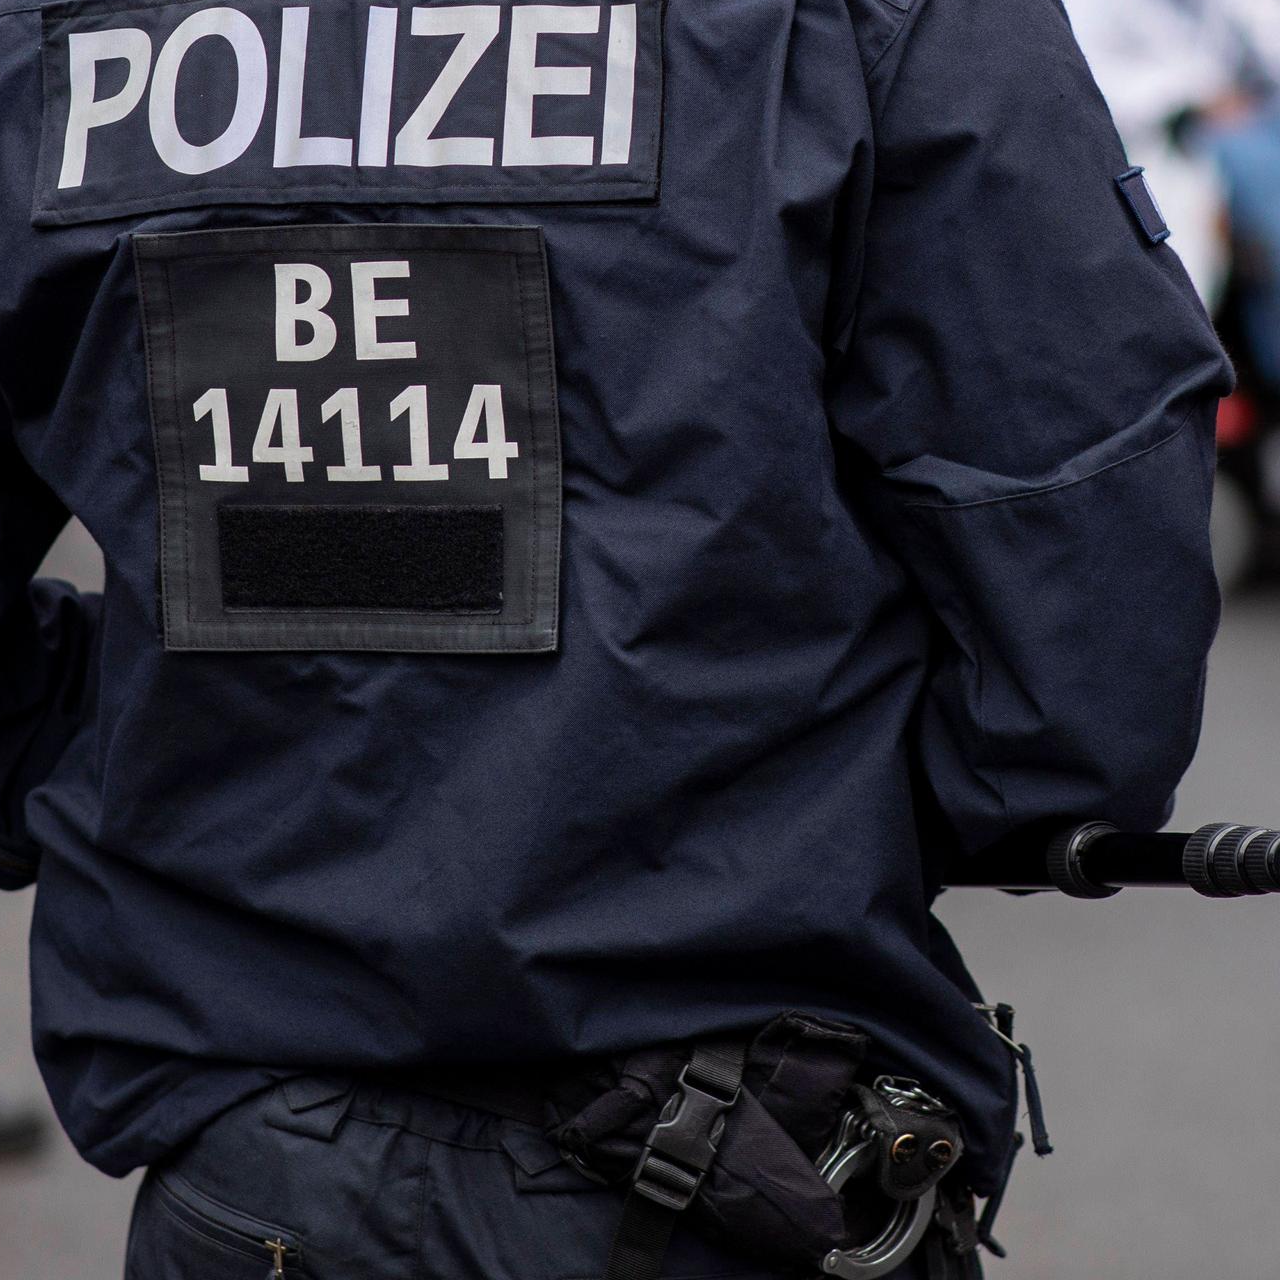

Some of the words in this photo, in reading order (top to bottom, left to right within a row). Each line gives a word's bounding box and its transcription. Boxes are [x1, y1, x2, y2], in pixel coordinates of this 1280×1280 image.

[57, 3, 637, 190] POLIZEI
[273, 260, 417, 362] BE
[192, 384, 519, 483] 14114
